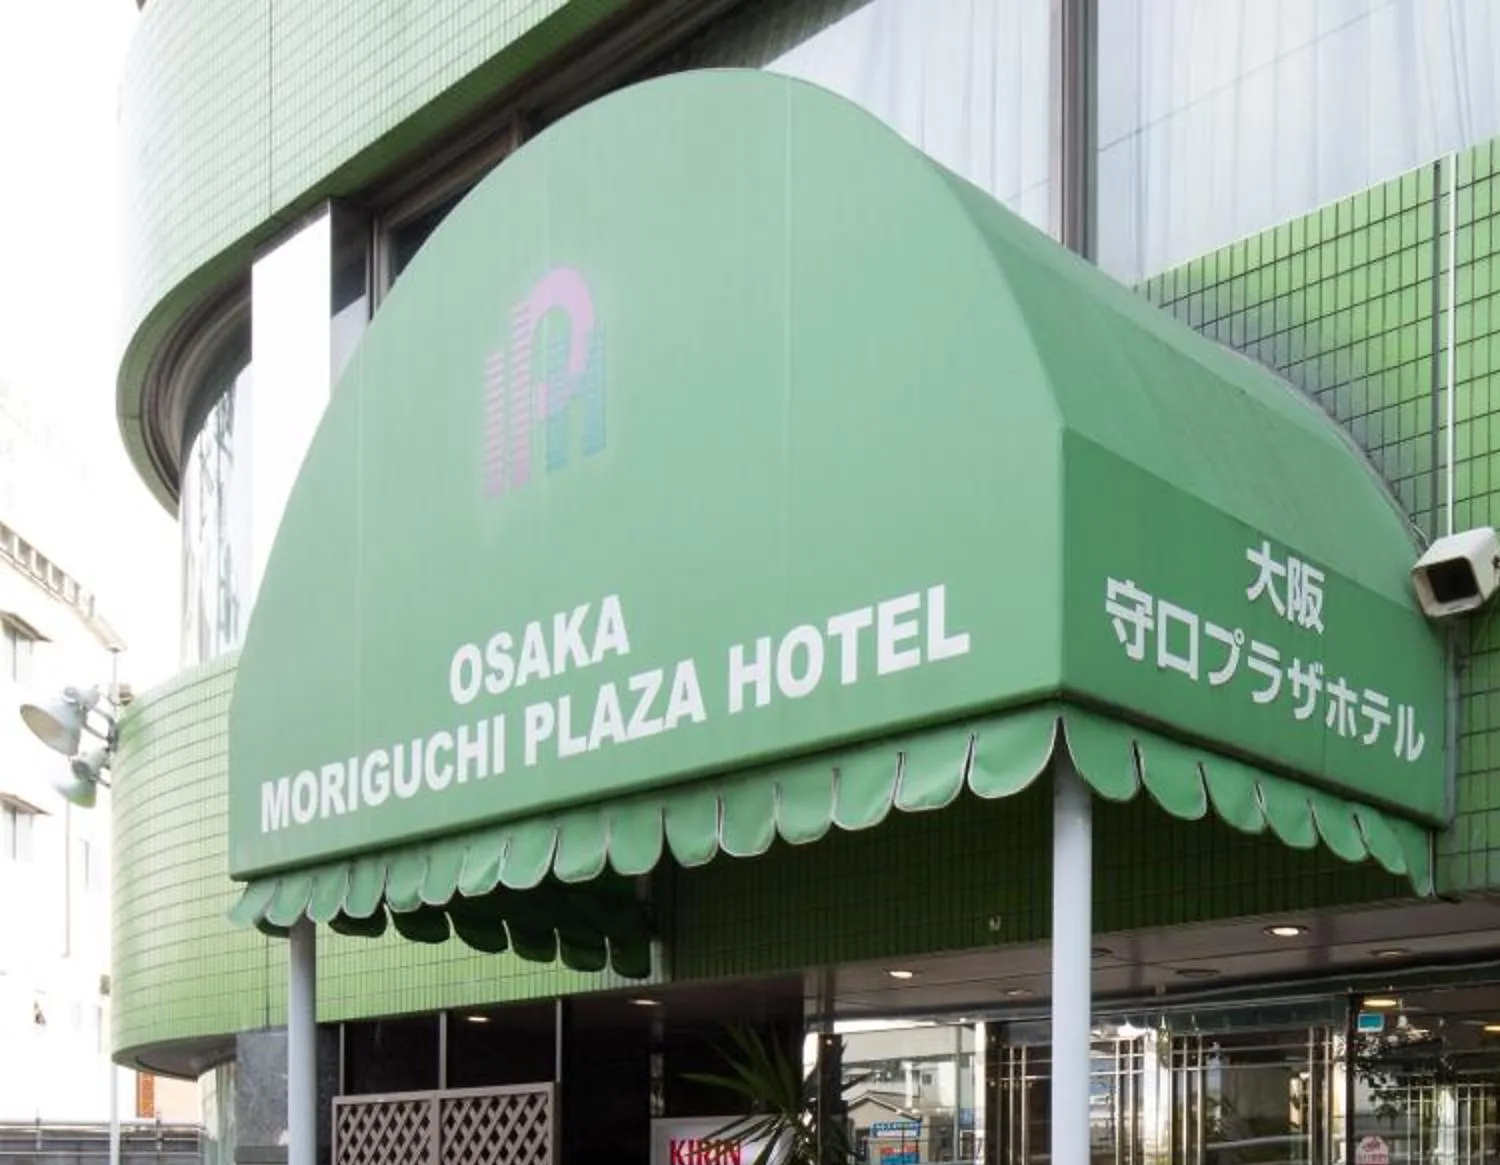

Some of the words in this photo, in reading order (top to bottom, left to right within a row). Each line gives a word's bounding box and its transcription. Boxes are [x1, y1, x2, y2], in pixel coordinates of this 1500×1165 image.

[449, 594, 630, 704] OSAKA
[1246, 540, 1325, 634] 大阪
[261, 714, 505, 833] MORIGUCHI
[525, 659, 707, 767] PLAZA
[728, 584, 970, 713] HOTEL
[1105, 576, 1425, 762] 守口プラザホテル
